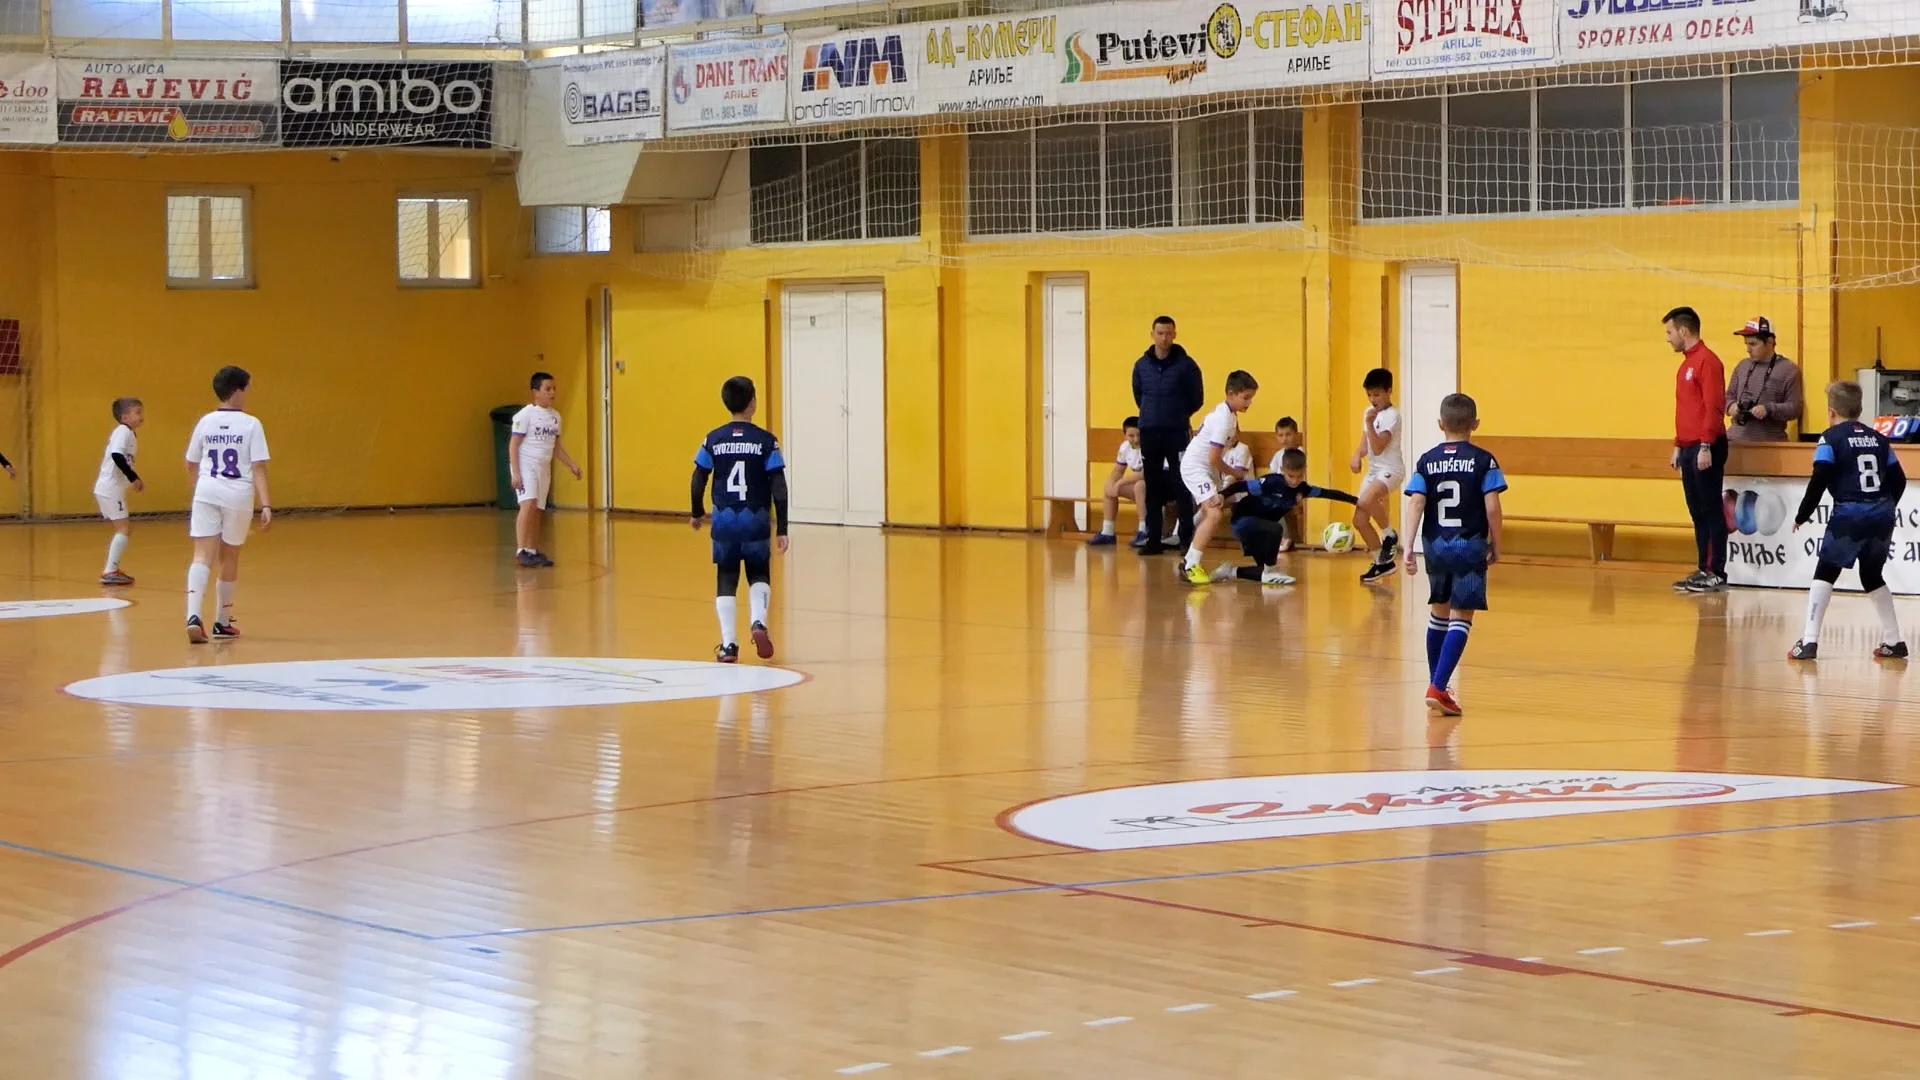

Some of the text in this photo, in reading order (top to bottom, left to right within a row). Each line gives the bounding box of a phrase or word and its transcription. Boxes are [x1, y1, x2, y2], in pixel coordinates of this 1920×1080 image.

[1397, 0, 1529, 54] STETEX
[1578, 23, 1673, 49] SPORTSKA
[1097, 24, 1207, 66] Putevi
[1441, 37, 1482, 50] ARILJE
[85, 63, 123, 74] AUTO
[696, 61, 734, 88] DANE
[739, 55, 788, 84] TRANS
[968, 66, 1013, 86] АРИЉЕ
[1287, 56, 1331, 73] АРИЉЕ
[12, 80, 49, 98] doo
[80, 73, 253, 99] RAJEVIĆ
[283, 69, 482, 114] amibo
[80, 108, 170, 123] RAJEVIĆ
[795, 94, 915, 120] profilisani limovi
[331, 122, 437, 138] UNDERWEAR
[205, 434, 243, 445] IVANJICA
[208, 448, 242, 479] 18
[1857, 454, 1881, 492] 8
[726, 460, 748, 501] 4
[1436, 480, 1463, 528] 2
[1729, 541, 1786, 569] РИЉЕ
